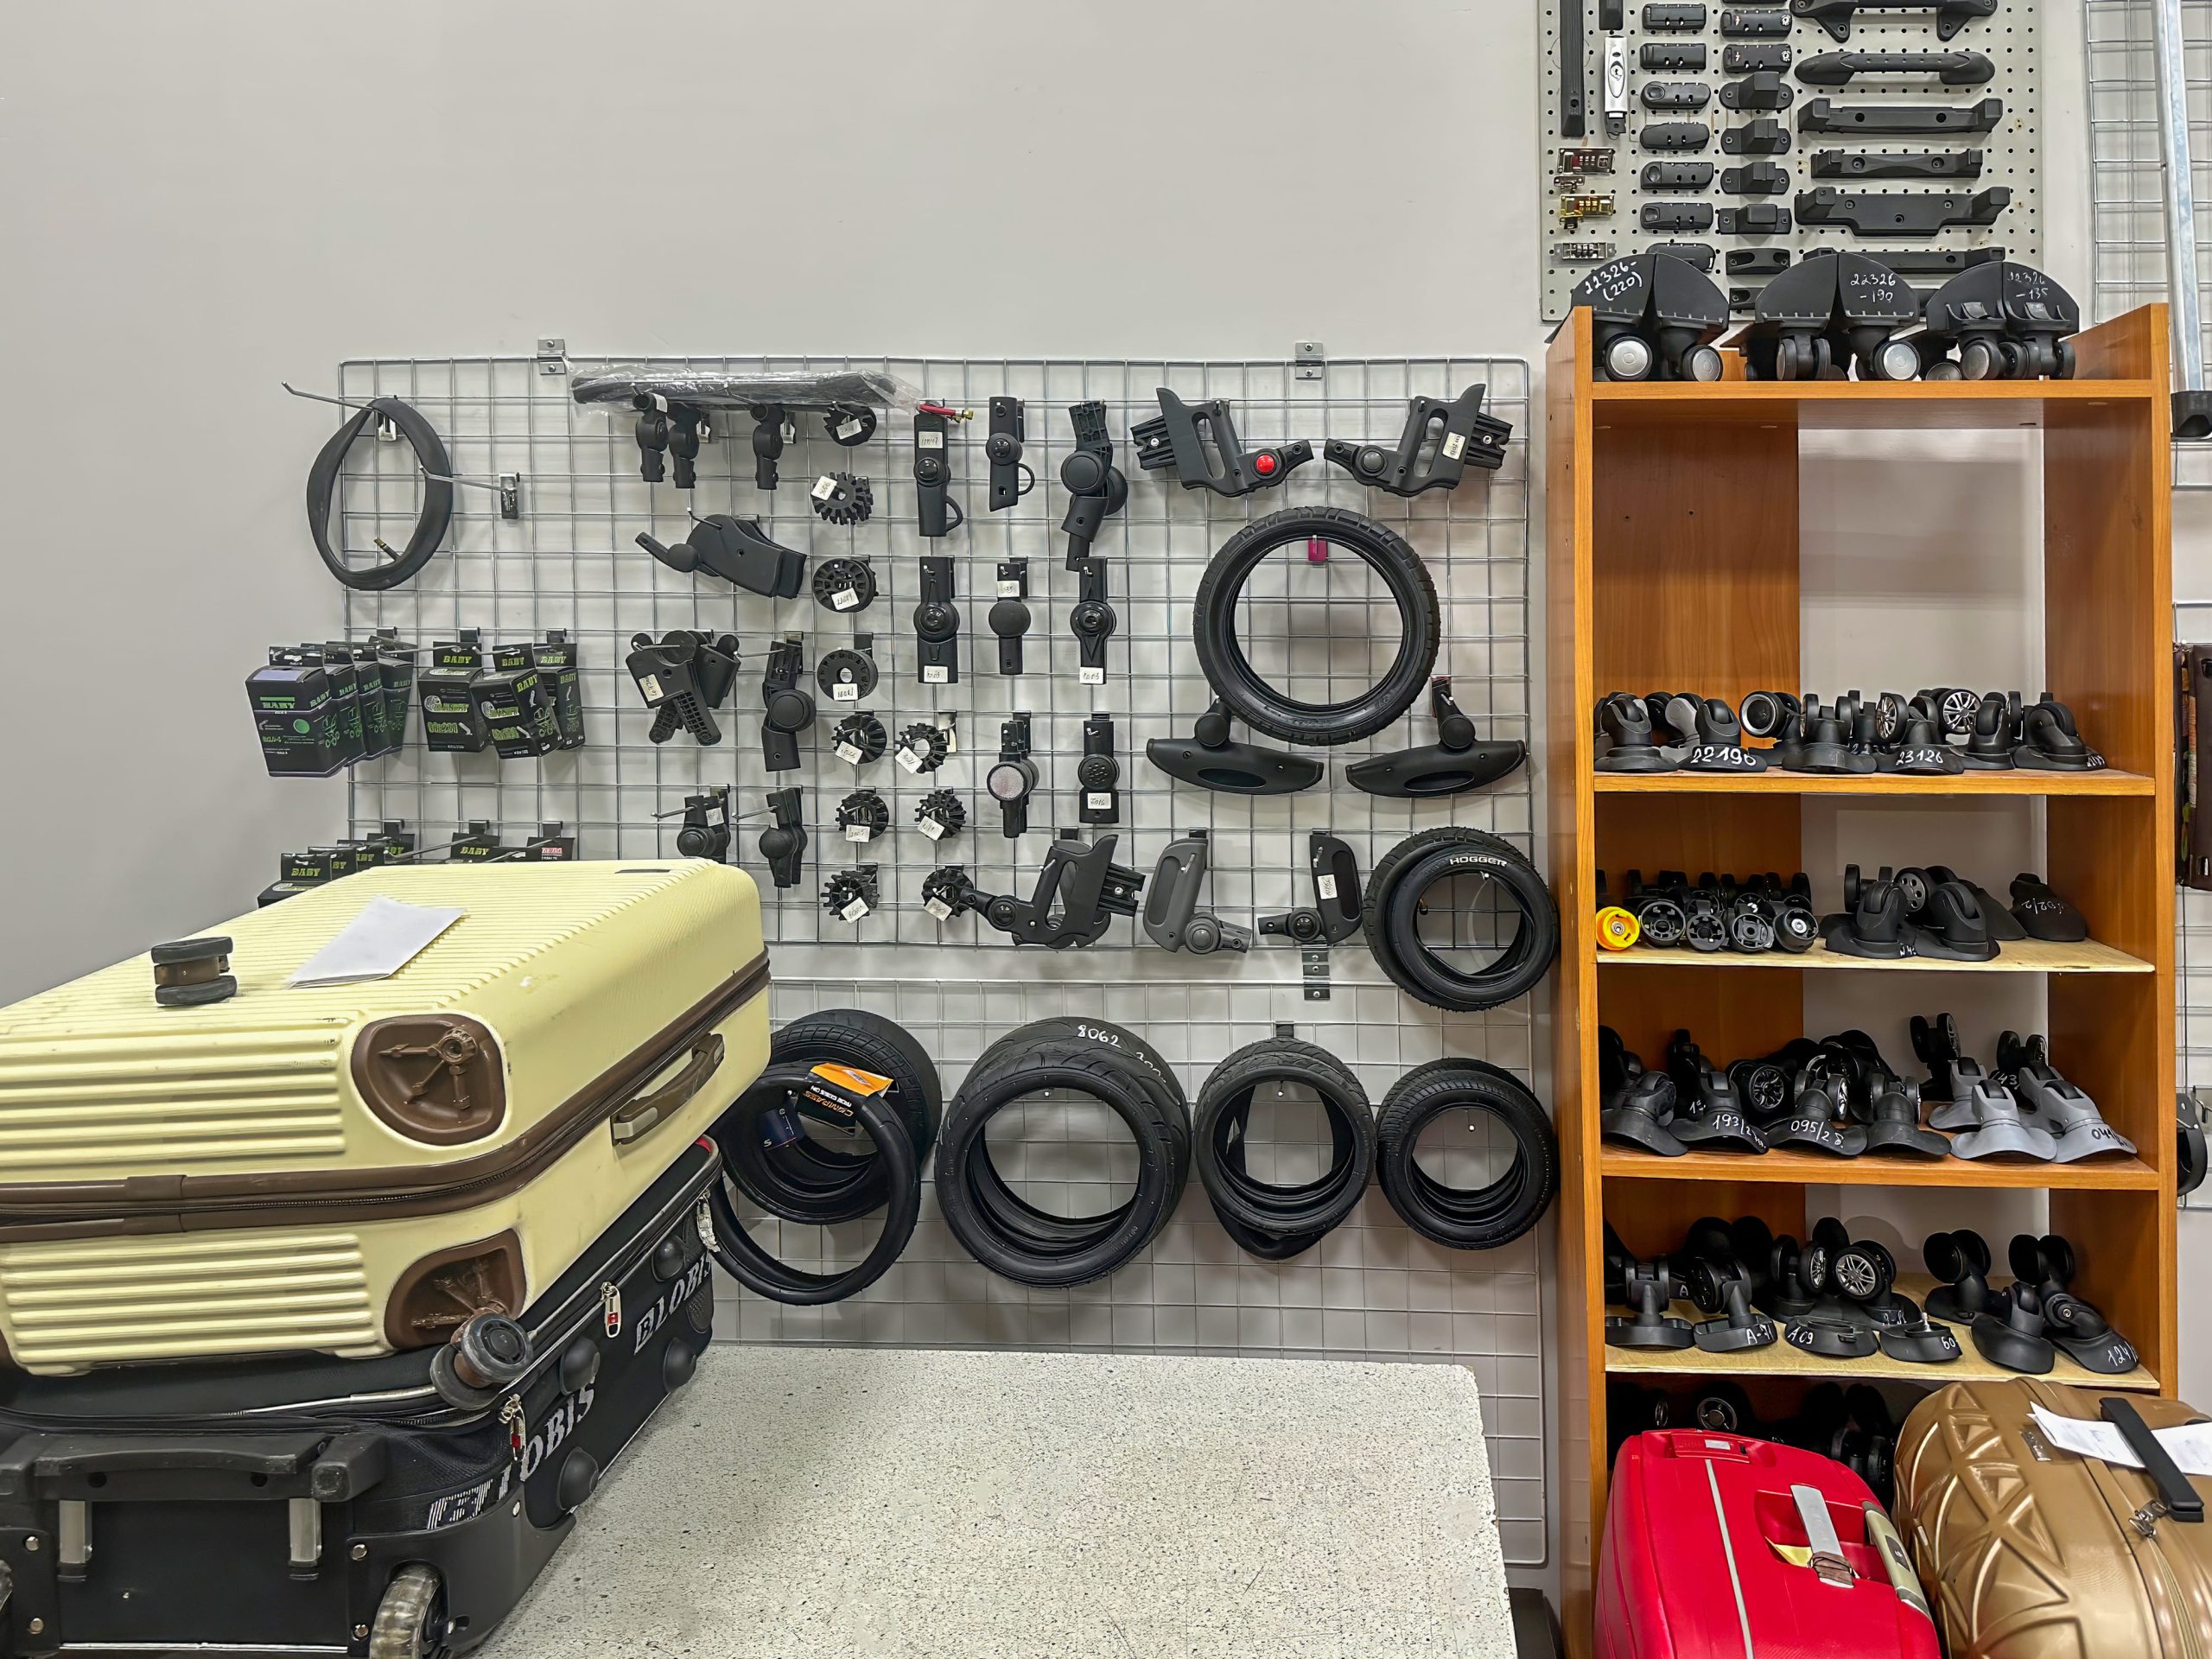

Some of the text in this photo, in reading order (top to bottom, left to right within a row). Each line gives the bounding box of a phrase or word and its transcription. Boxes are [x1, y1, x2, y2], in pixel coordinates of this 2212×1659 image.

[1850, 272, 1896, 286] 22326
[1603, 271, 1643, 302] (220)
[442, 655, 473, 664] BABY
[501, 657, 524, 667] BABY
[539, 655, 567, 664] BABY
[517, 674, 538, 693] BABY
[262, 701, 296, 709] BABY
[1690, 746, 1757, 766] 22190
[1896, 749, 1944, 766] 23126
[460, 846, 490, 855] BABY
[1449, 855, 1508, 868] HOGGER
[290, 868, 321, 877] BABY
[1077, 1024, 1122, 1049] 8062
[804, 1090, 854, 1117] COMPASS
[1790, 1119, 1830, 1141] 095/2
